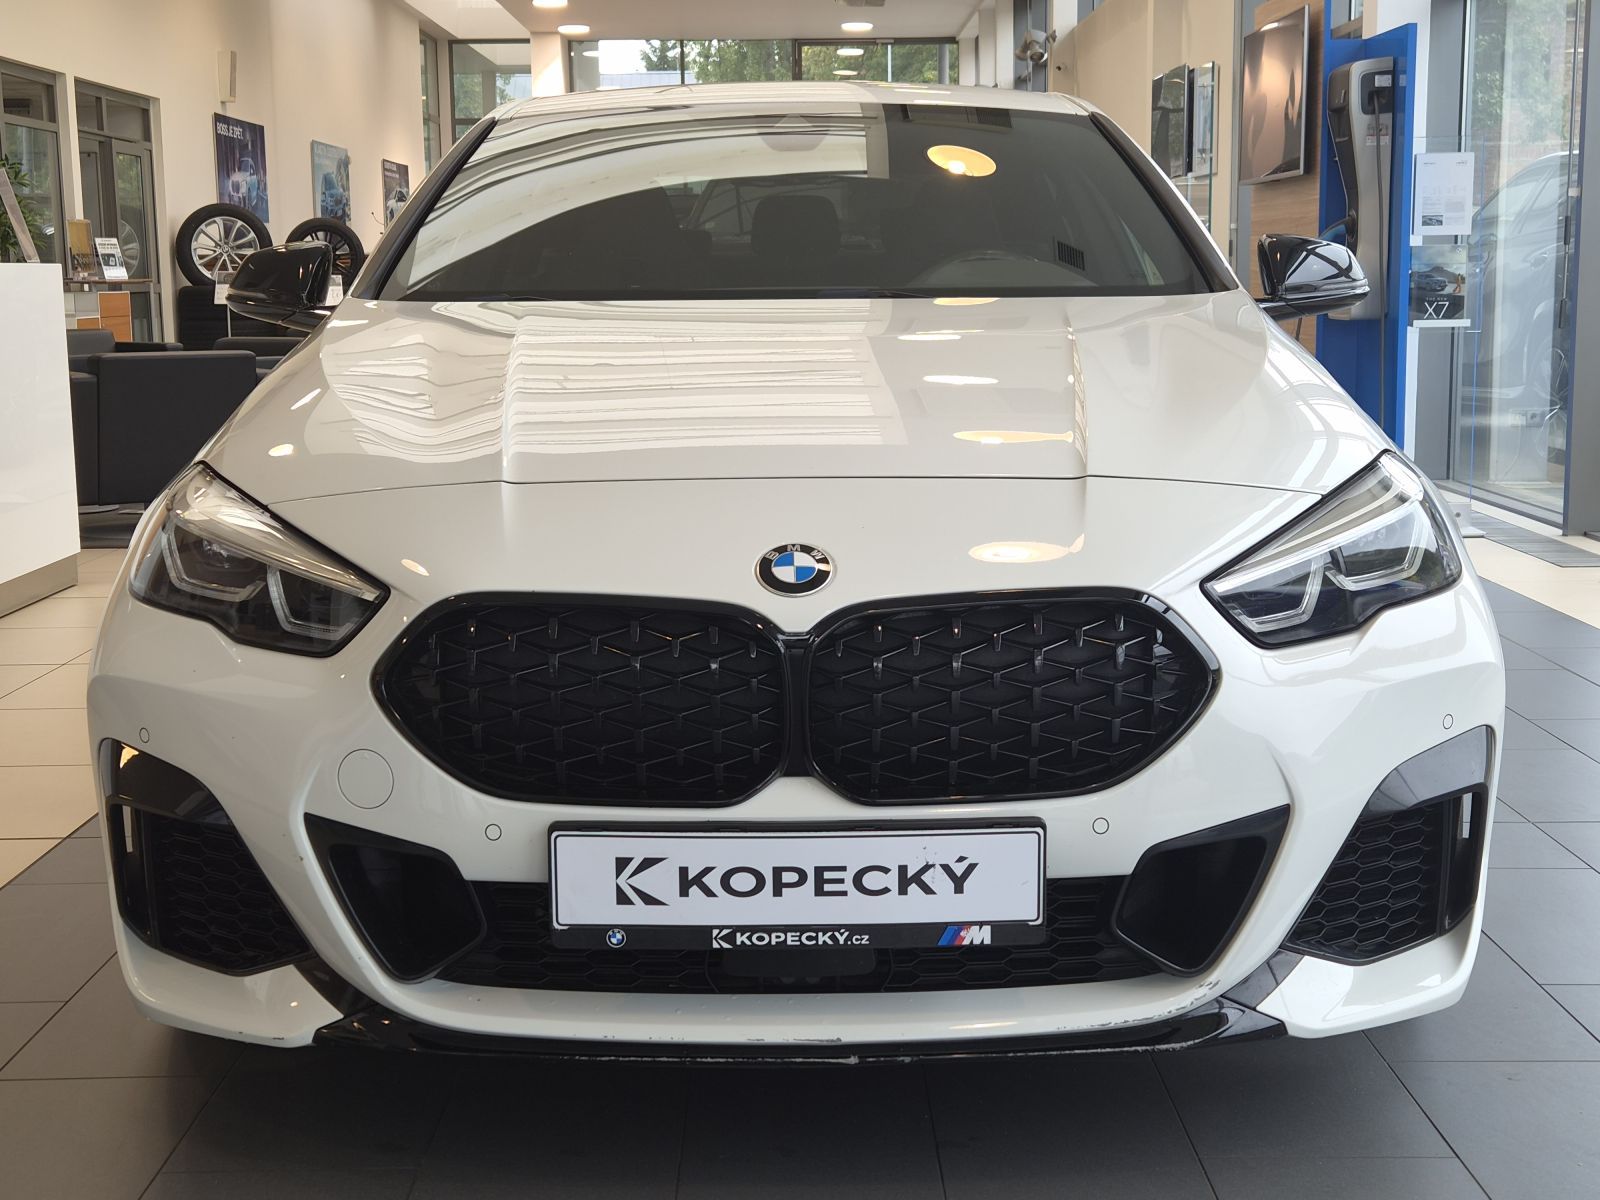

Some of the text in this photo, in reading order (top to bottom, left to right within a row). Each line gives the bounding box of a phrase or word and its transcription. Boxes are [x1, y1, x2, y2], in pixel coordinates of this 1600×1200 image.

[216, 122, 228, 136] BOSS
[1424, 301, 1449, 319] X7
[765, 544, 825, 560] BMW
[678, 855, 980, 898] KOPECKÝ
[735, 928, 870, 946] KOPECKÝ.cz
